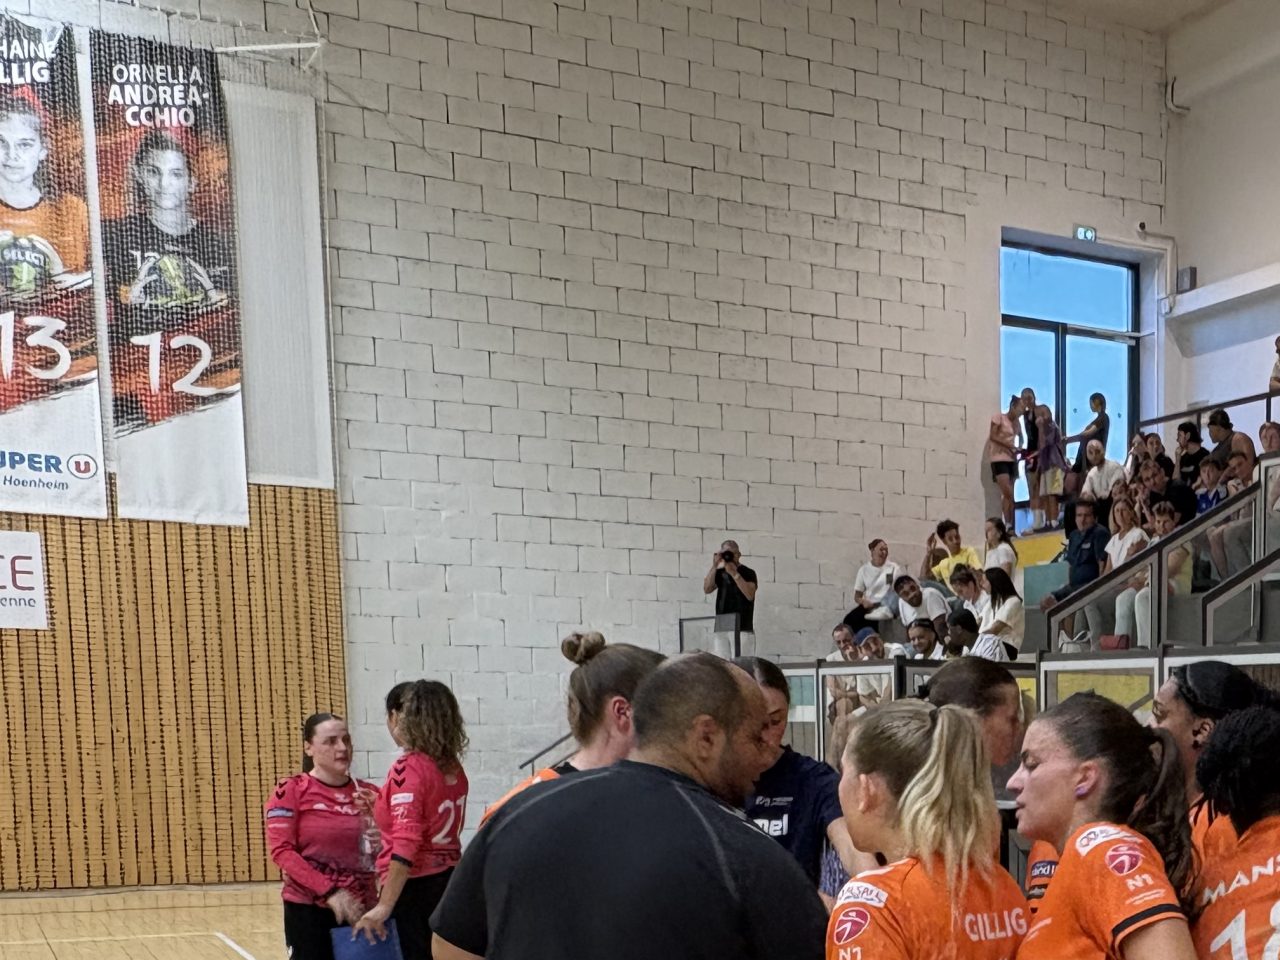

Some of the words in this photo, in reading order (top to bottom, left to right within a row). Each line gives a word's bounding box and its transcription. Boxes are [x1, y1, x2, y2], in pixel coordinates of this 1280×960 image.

[112, 63, 204, 85] ORNELLA
[107, 84, 210, 106] ANDREA-
[125, 105, 196, 128] CCHIO
[0, 311, 72, 381] 13
[130, 331, 241, 396] 12
[3, 475, 70, 491] Hoenheim
[431, 794, 466, 845] 21
[964, 907, 1028, 943] GILLIG
